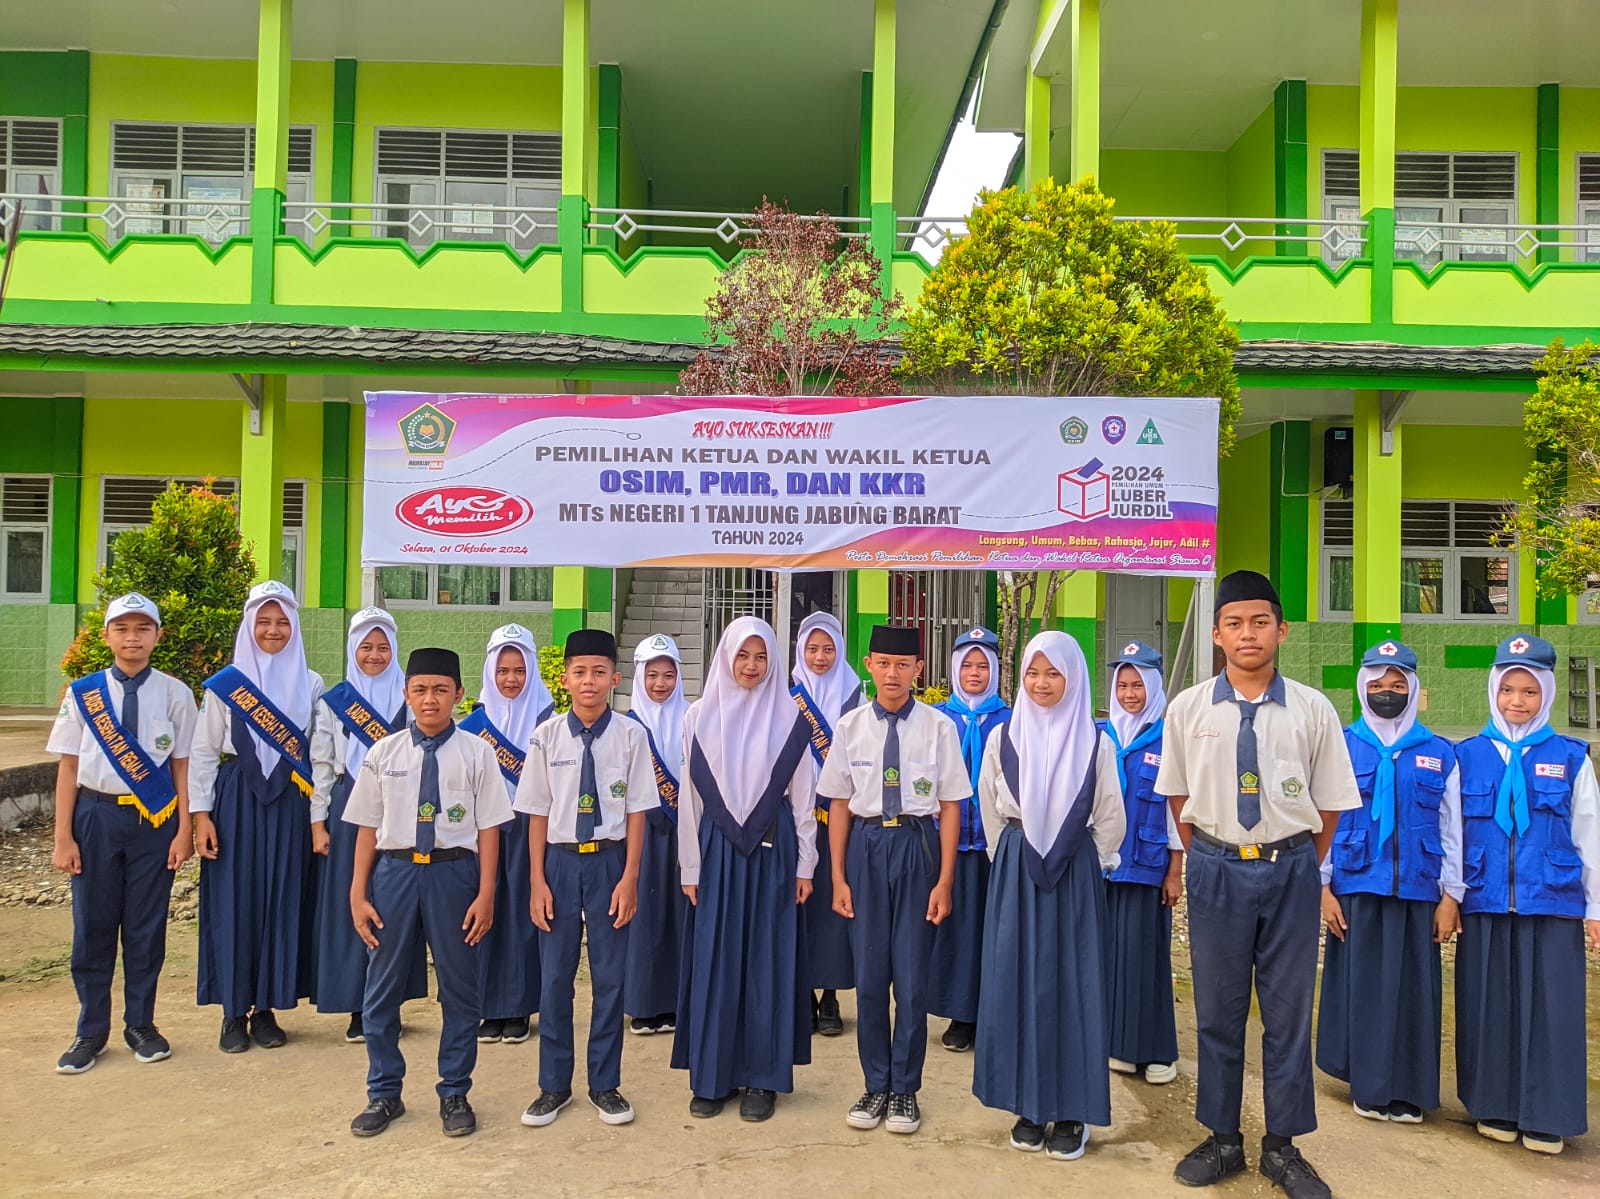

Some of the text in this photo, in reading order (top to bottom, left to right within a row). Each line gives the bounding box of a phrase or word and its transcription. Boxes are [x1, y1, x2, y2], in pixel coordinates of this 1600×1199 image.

[692, 420, 725, 438] AYO
[535, 446, 991, 465] PEMILIHAN KETUA DAN WAKIL KETUA
[599, 469, 926, 497] OSIM, PMR, DAN KKR
[1111, 466, 1165, 482] 2024
[1111, 489, 1166, 502] LUBER
[559, 503, 962, 525] MTs NEGERI 1 TANJUNG JABUNG BARAT
[1111, 503, 1171, 518] JURDIL
[712, 530, 804, 545] TAHUN 2024
[978, 534, 1028, 547] Langsung,
[1031, 535, 1066, 547] Umum,
[1069, 535, 1101, 547] Bebas,
[1149, 536, 1177, 549] Jujur,
[1180, 537, 1199, 548] Adil
[400, 542, 436, 554] Selasa,
[454, 542, 497, 553] Oktober
[498, 545, 529, 554] 2024
[845, 550, 872, 561] Pesta
[876, 550, 929, 562] Demokrasi
[931, 550, 984, 562] Pemilihan
[987, 550, 1018, 563] Ketua
[1020, 551, 1041, 563] dan
[1044, 551, 1077, 563] Wakil
[1079, 551, 1111, 563] Ketua
[1113, 552, 1166, 568] Organisasi
[1169, 553, 1200, 566] Siswa
[228, 685, 259, 712] KADER
[249, 704, 291, 745] KESEHATAN
[345, 701, 371, 727] KADER
[82, 688, 150, 784] KADER KESEHATAN REMAJA
